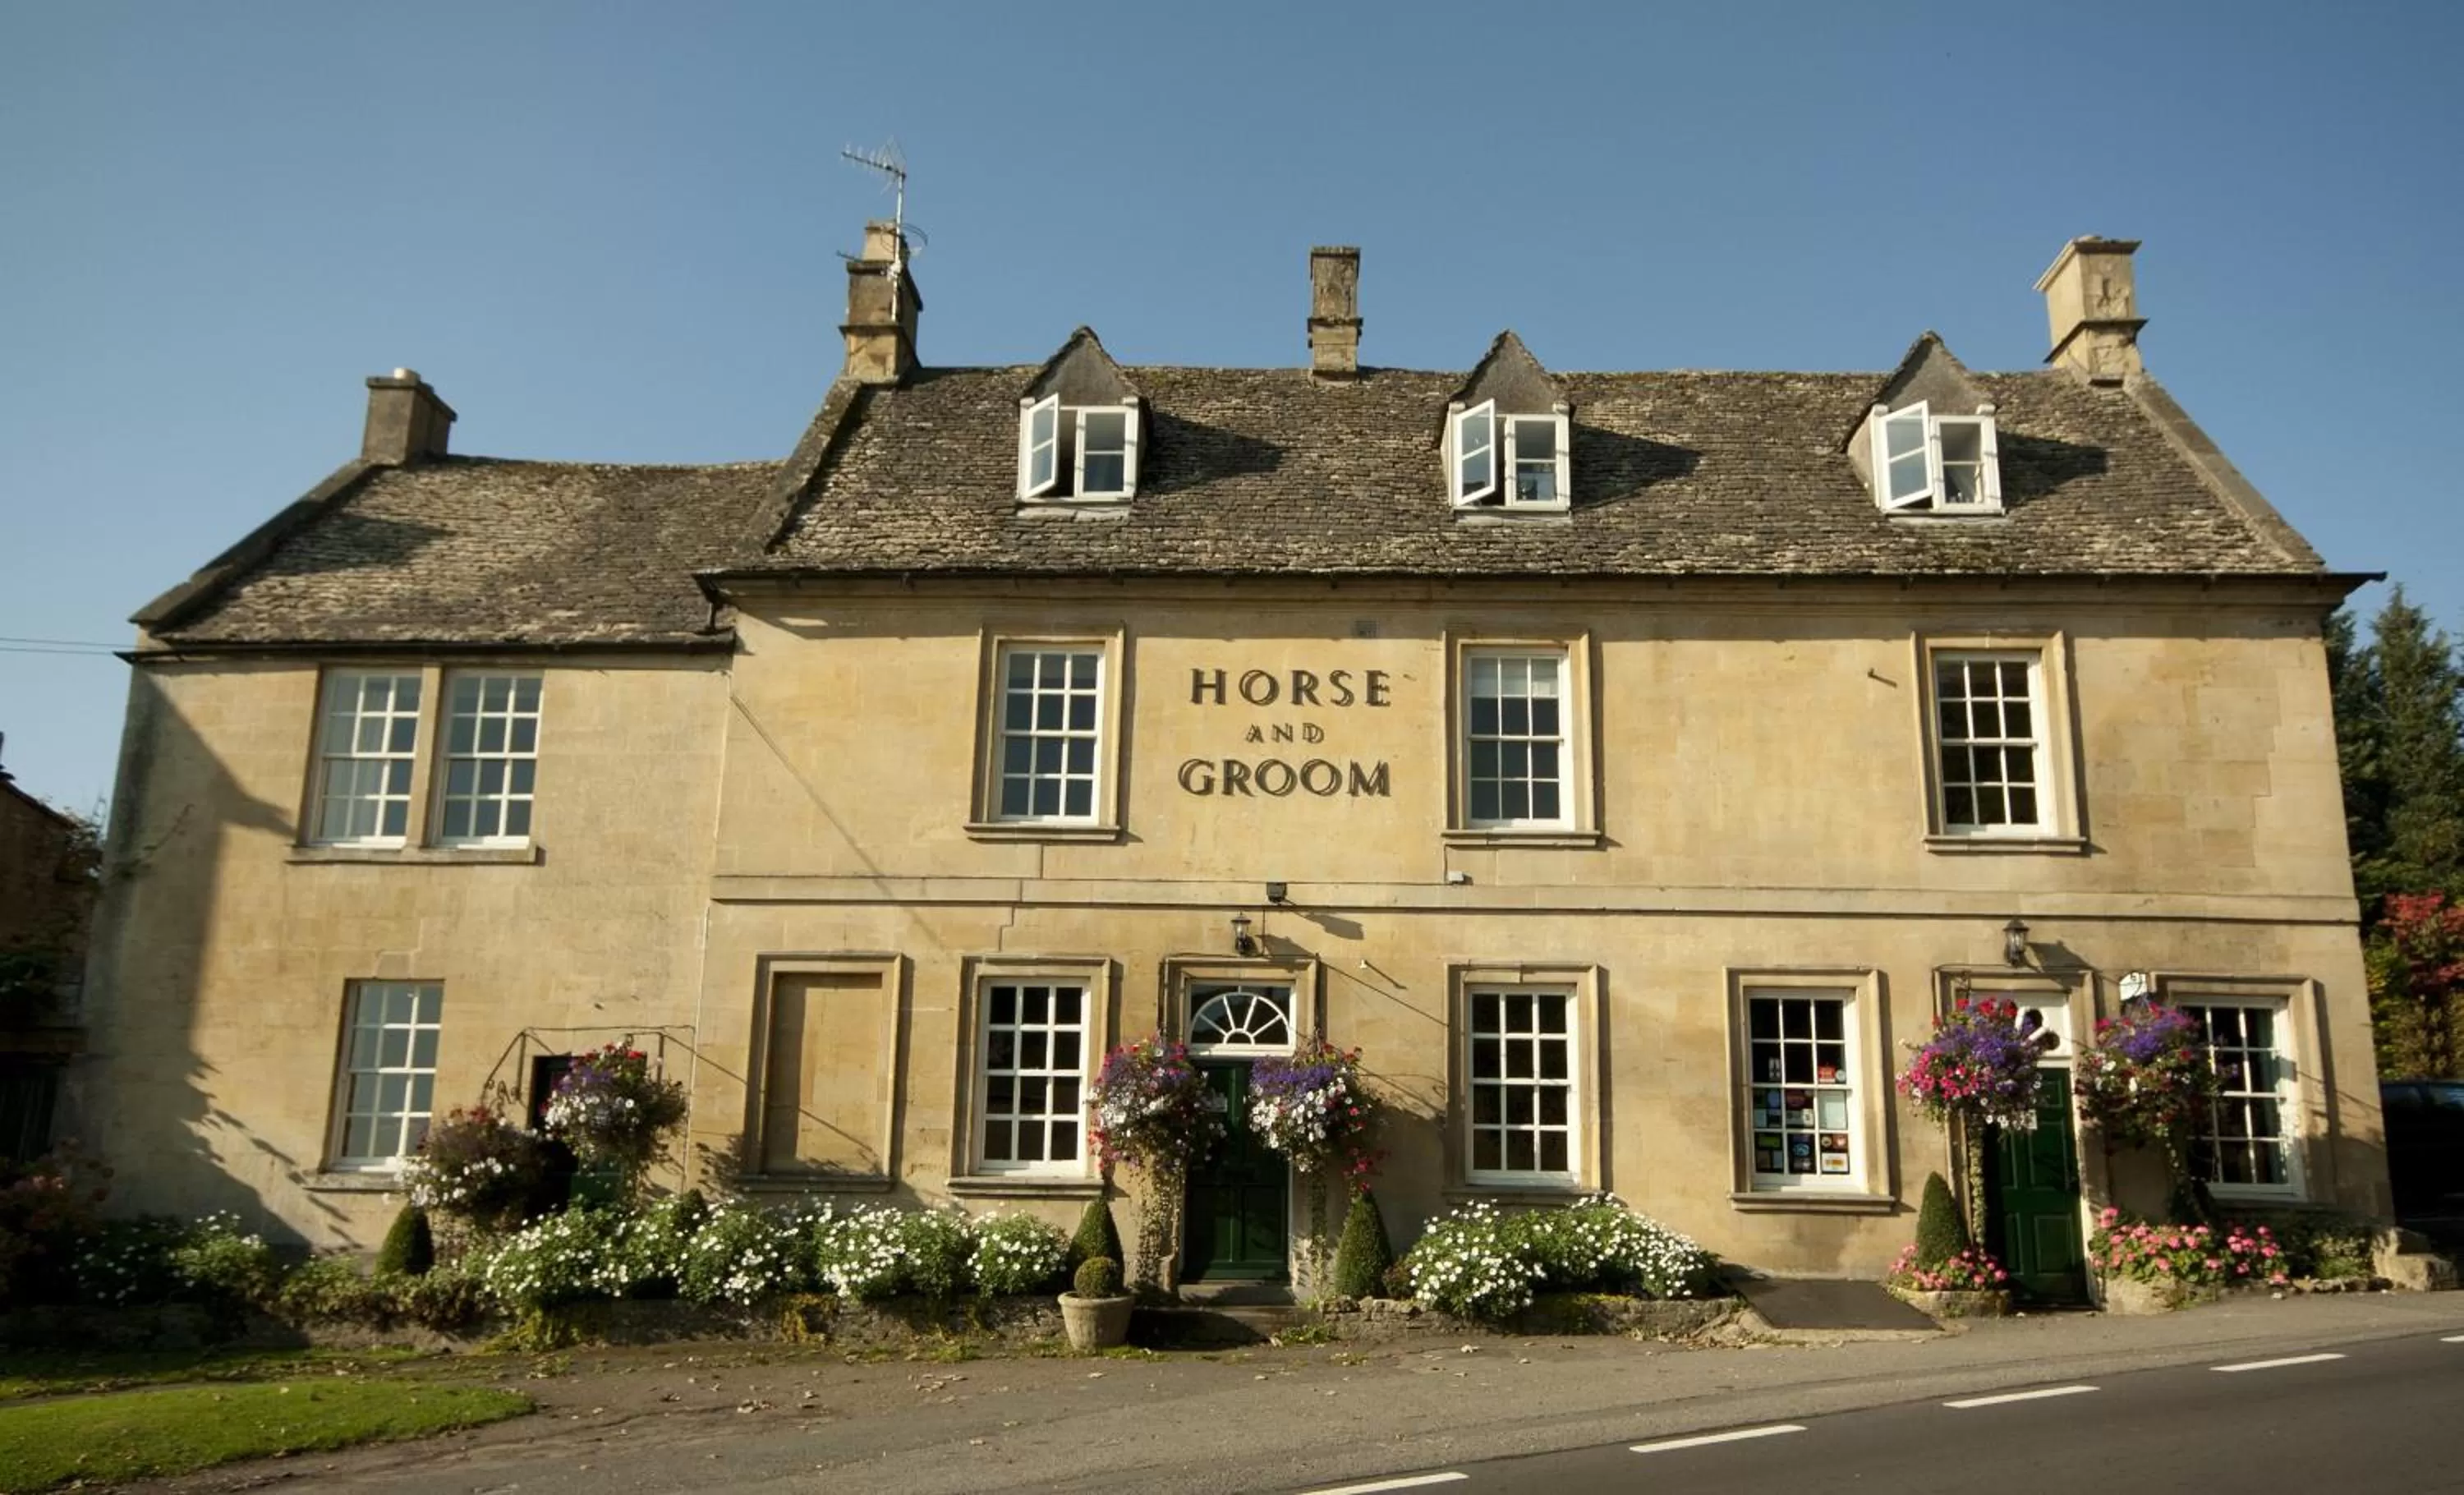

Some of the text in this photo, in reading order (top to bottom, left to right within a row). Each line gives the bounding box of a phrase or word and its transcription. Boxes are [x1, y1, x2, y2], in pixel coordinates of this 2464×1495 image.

[1191, 669, 1391, 707] HORSE
[1246, 722, 1325, 744] AND
[1178, 758, 1391, 797] GROOM
